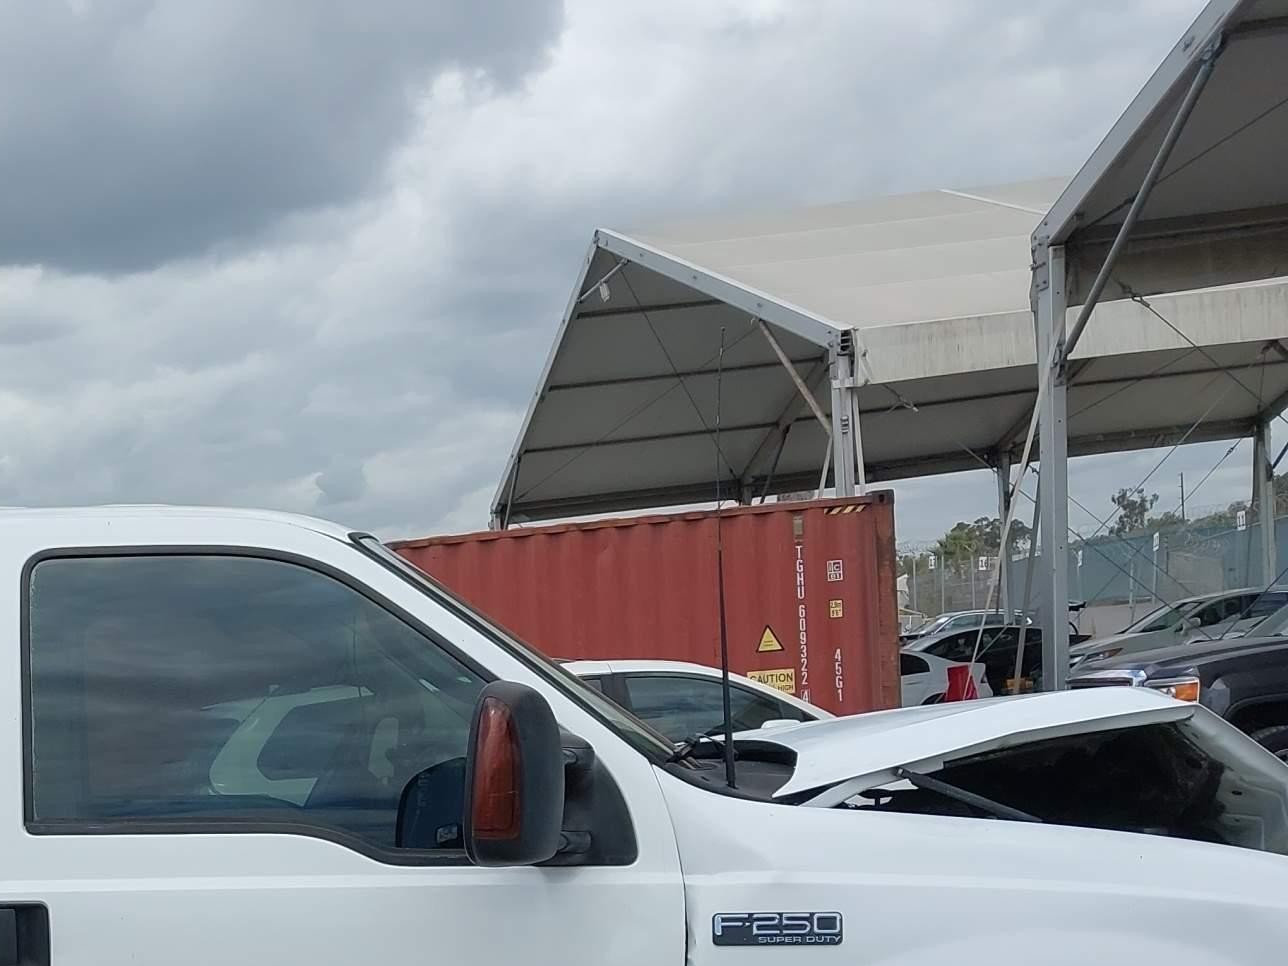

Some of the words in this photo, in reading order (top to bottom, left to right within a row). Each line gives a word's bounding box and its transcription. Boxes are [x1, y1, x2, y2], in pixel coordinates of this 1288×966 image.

[795, 545, 805, 599] TGHU
[798, 605, 808, 685] 609322
[834, 648, 843, 702] 45G1
[714, 913, 841, 935] F-250
[806, 935, 841, 943] DUTY
